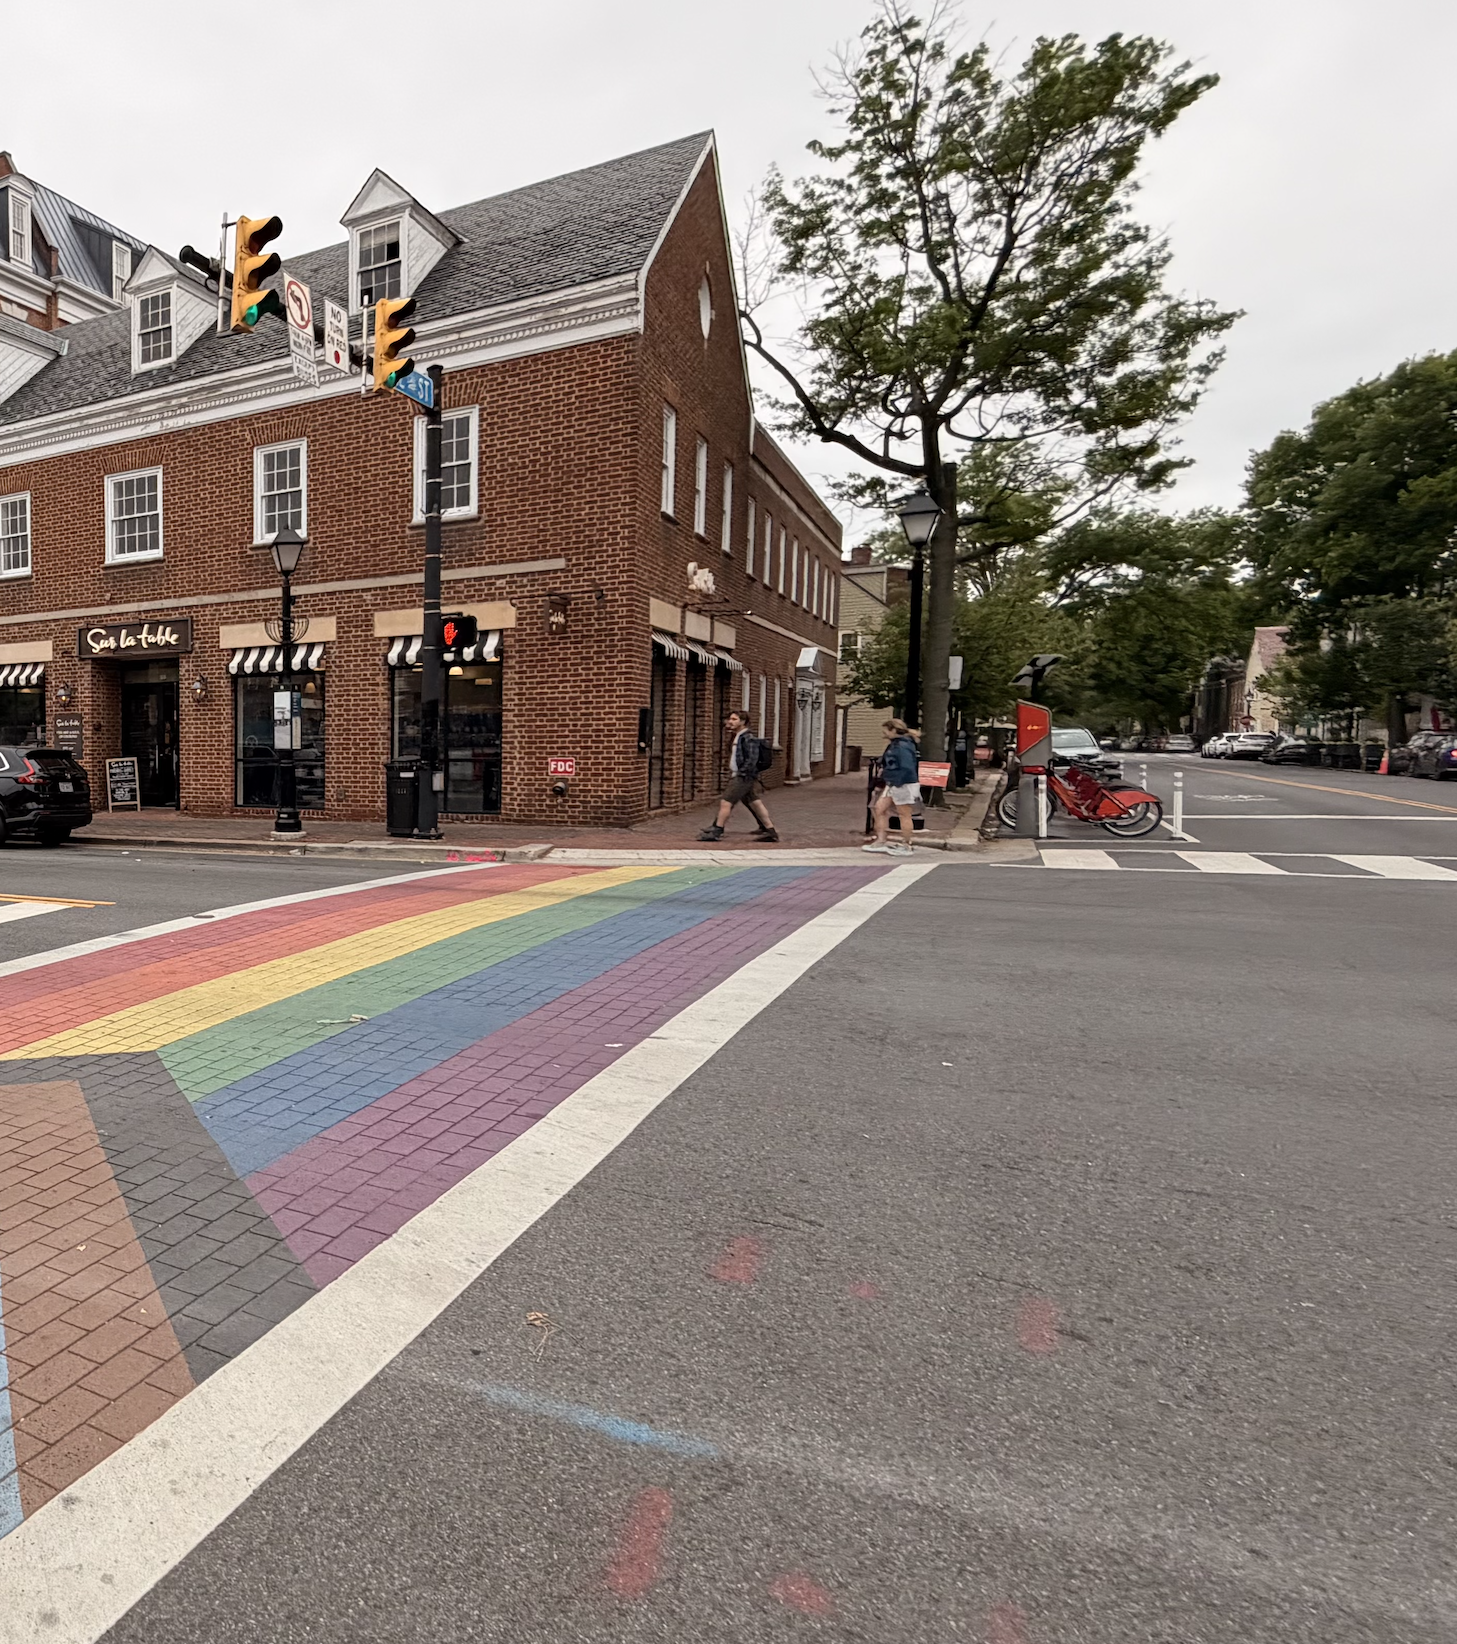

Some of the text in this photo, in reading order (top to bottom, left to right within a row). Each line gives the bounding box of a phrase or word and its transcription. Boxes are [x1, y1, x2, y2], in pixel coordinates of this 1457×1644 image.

[331, 307, 342, 323] NO
[417, 377, 430, 402] ST
[86, 624, 179, 653] Sur la table
[550, 761, 573, 772] FDC
